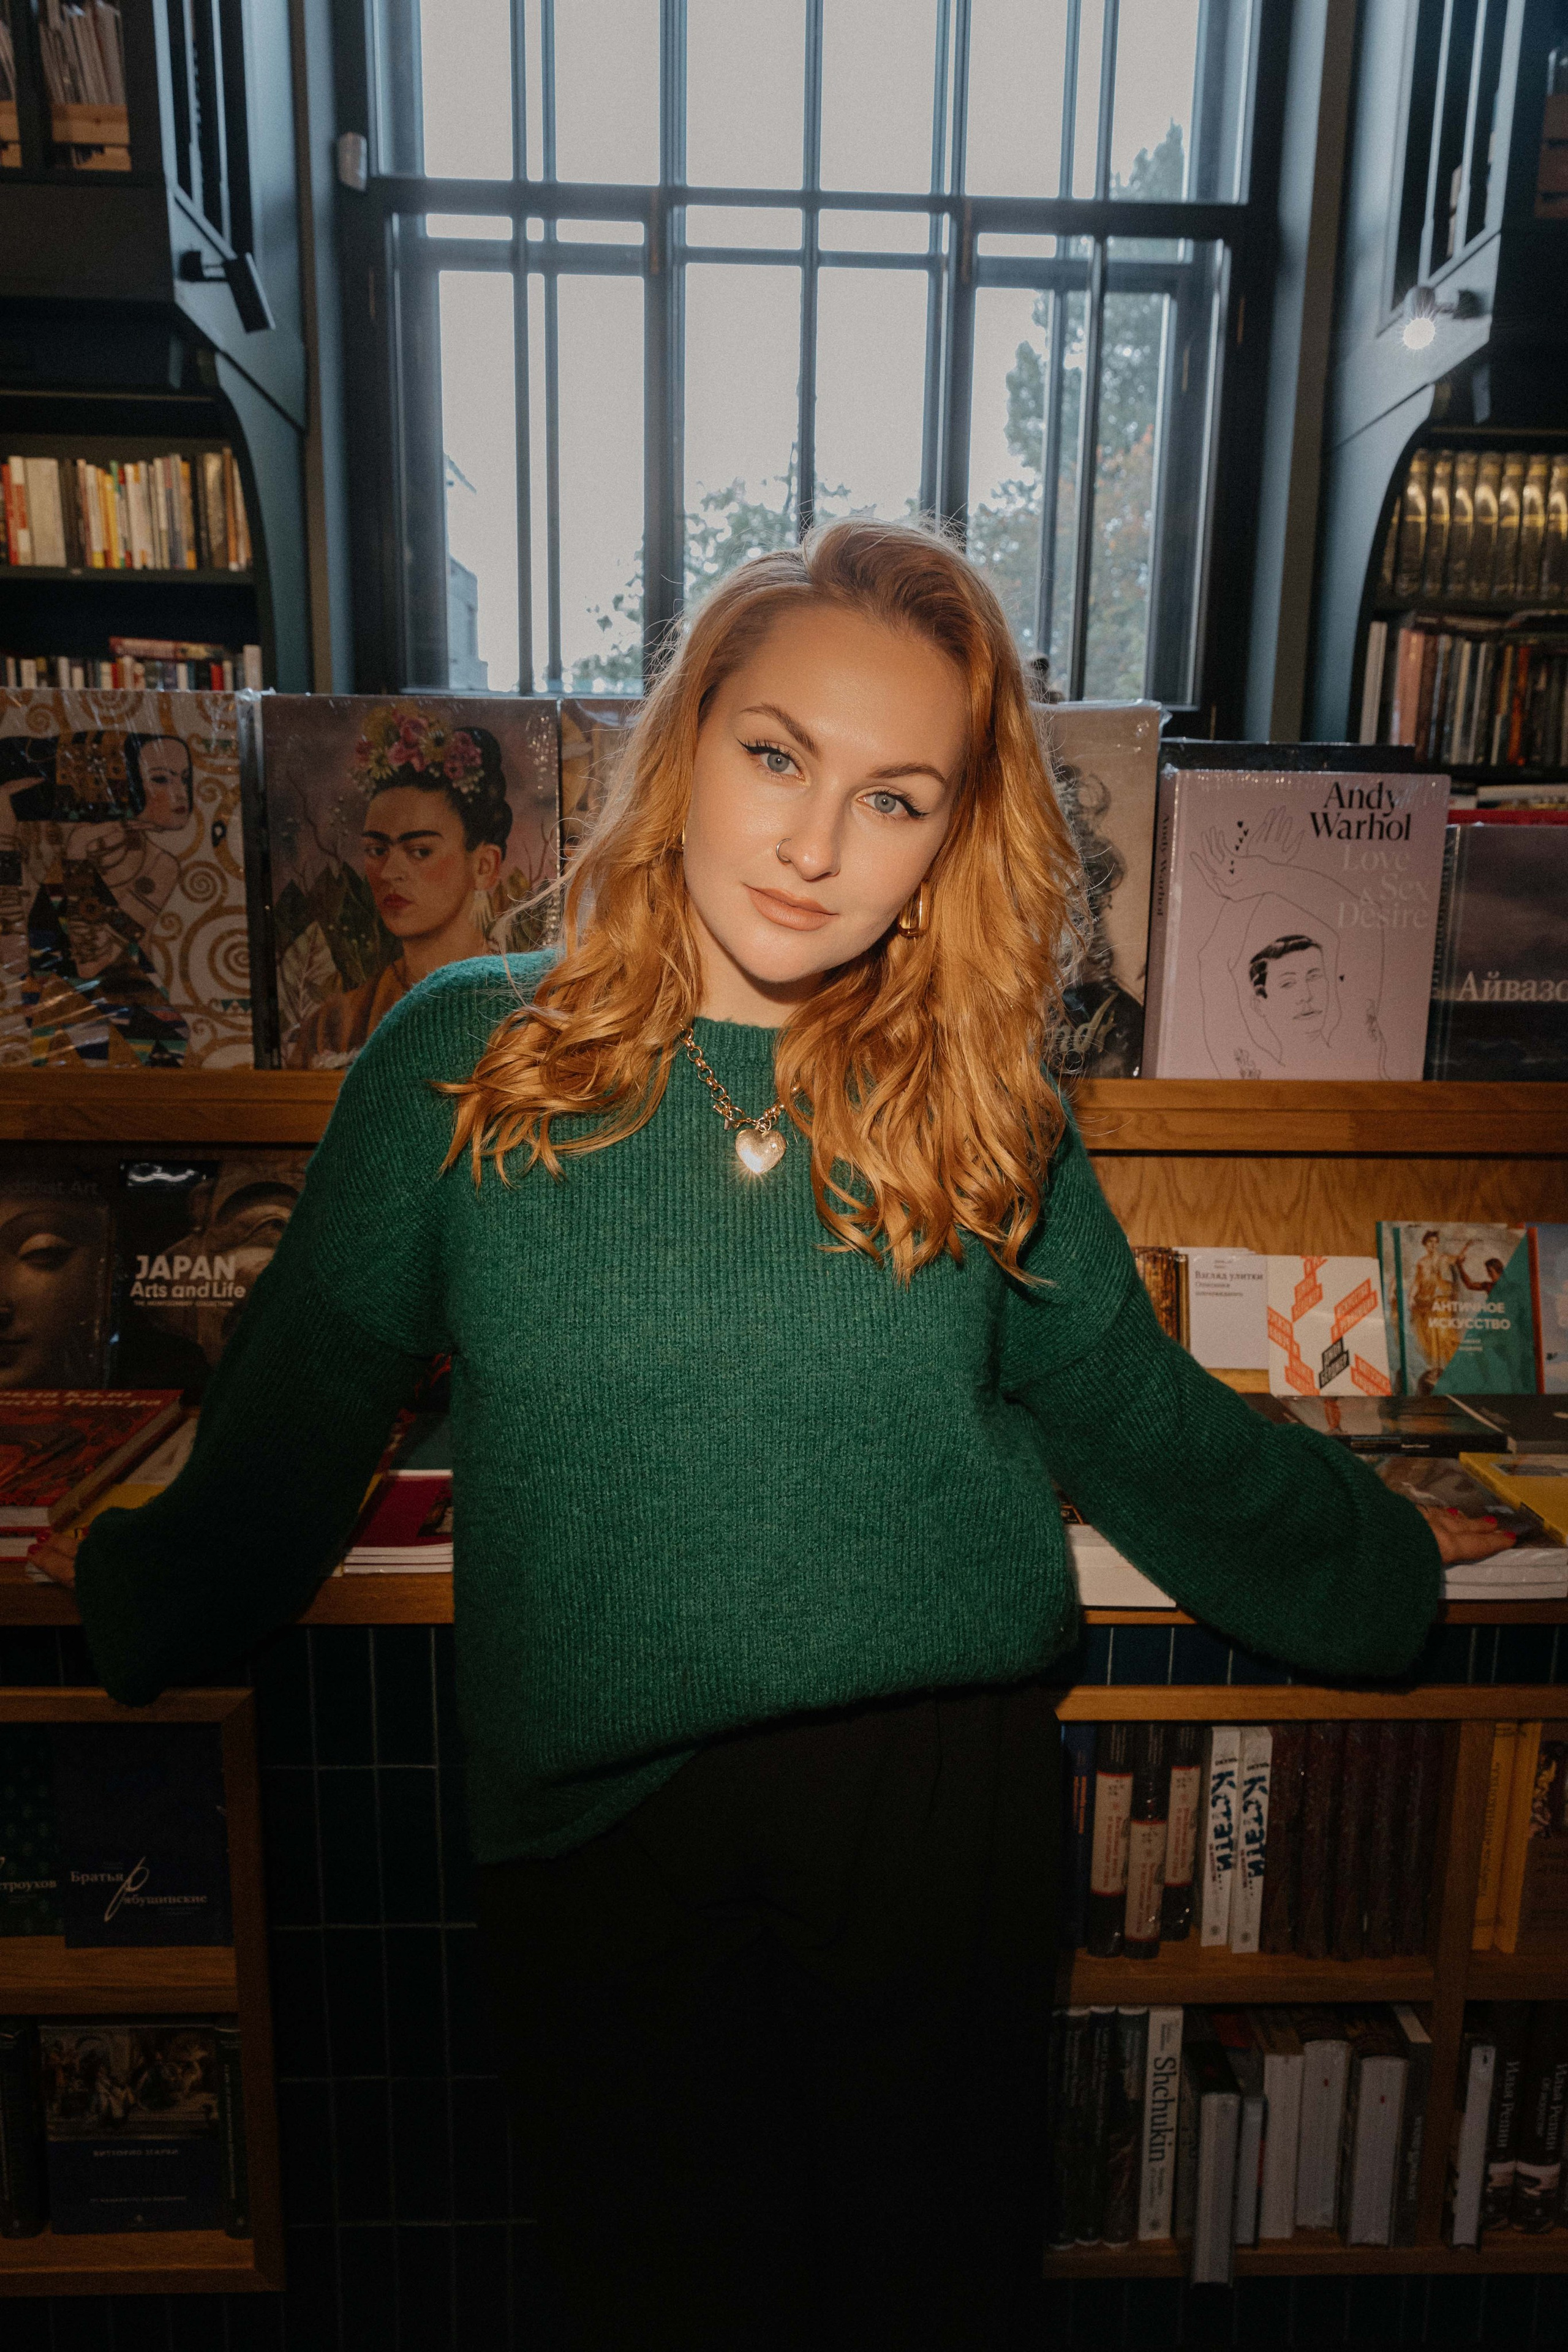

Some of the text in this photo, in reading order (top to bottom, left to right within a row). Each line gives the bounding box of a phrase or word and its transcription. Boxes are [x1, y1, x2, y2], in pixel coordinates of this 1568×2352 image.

[1324, 781, 1395, 817] Andy
[1310, 812, 1411, 841] Warhol
[1157, 813, 1170, 916] Andy Warhol
[1343, 844, 1409, 871] Love
[1380, 873, 1428, 902] Sex
[1338, 902, 1428, 929] Desire
[135, 1255, 236, 1281] JAPAN
[1194, 1271, 1227, 1280] Взгляд
[130, 1281, 247, 1298] Arts and Life
[1431, 1300, 1505, 1314] АНТИЧНОЕ
[1427, 1317, 1511, 1330] ИСКУССТВО
[70, 1870, 124, 1885] Братья
[1148, 2056, 1177, 2163] Shchukin
[1497, 2102, 1517, 2148] Репин
[1545, 2105, 1563, 2151] Репин
